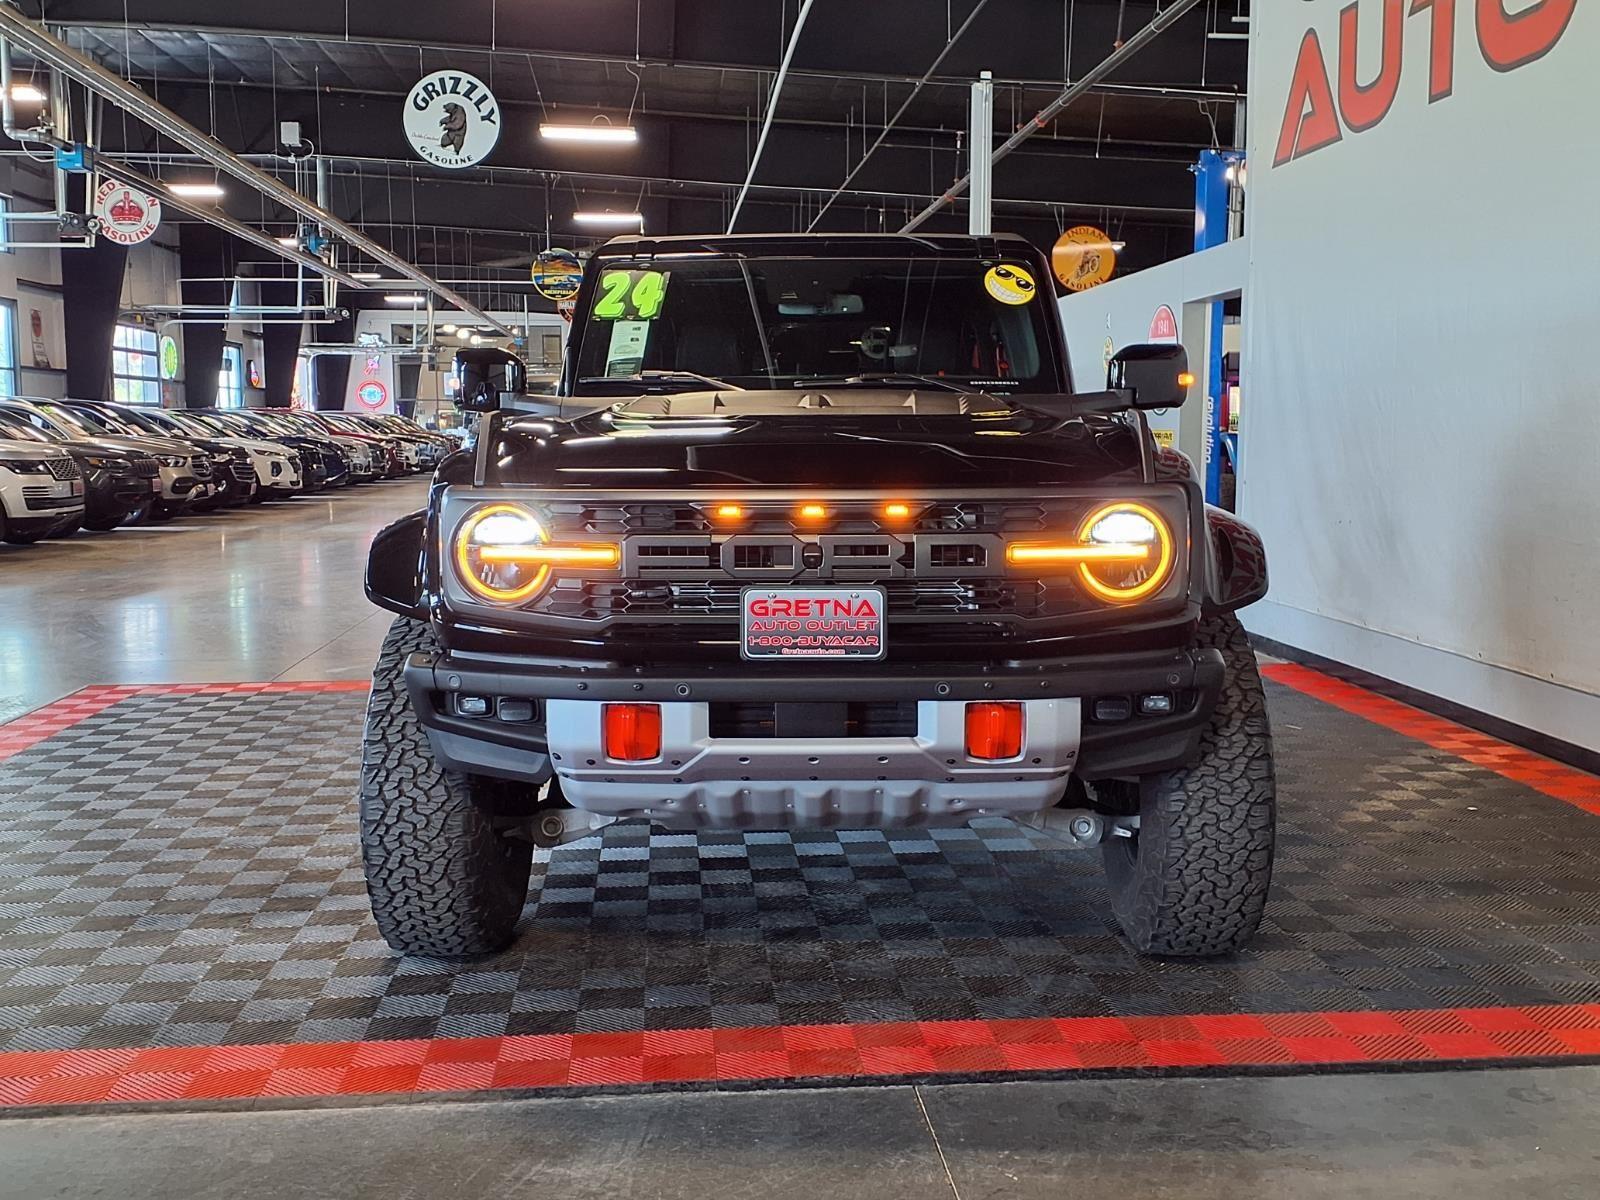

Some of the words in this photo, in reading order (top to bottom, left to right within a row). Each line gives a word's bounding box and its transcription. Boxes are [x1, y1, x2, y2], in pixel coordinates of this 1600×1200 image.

[413, 76, 496, 125] GRIZZLY
[420, 146, 474, 165] GASOLINE
[97, 181, 116, 205] RED
[1066, 227, 1104, 240] INDIAN
[594, 271, 664, 318] 24
[622, 533, 1004, 578] FORD
[750, 598, 878, 617] GRETNA
[750, 620, 801, 631] AUTO
[806, 620, 879, 631] OUTLET
[748, 635, 879, 646] 1-800-BUYACAR
